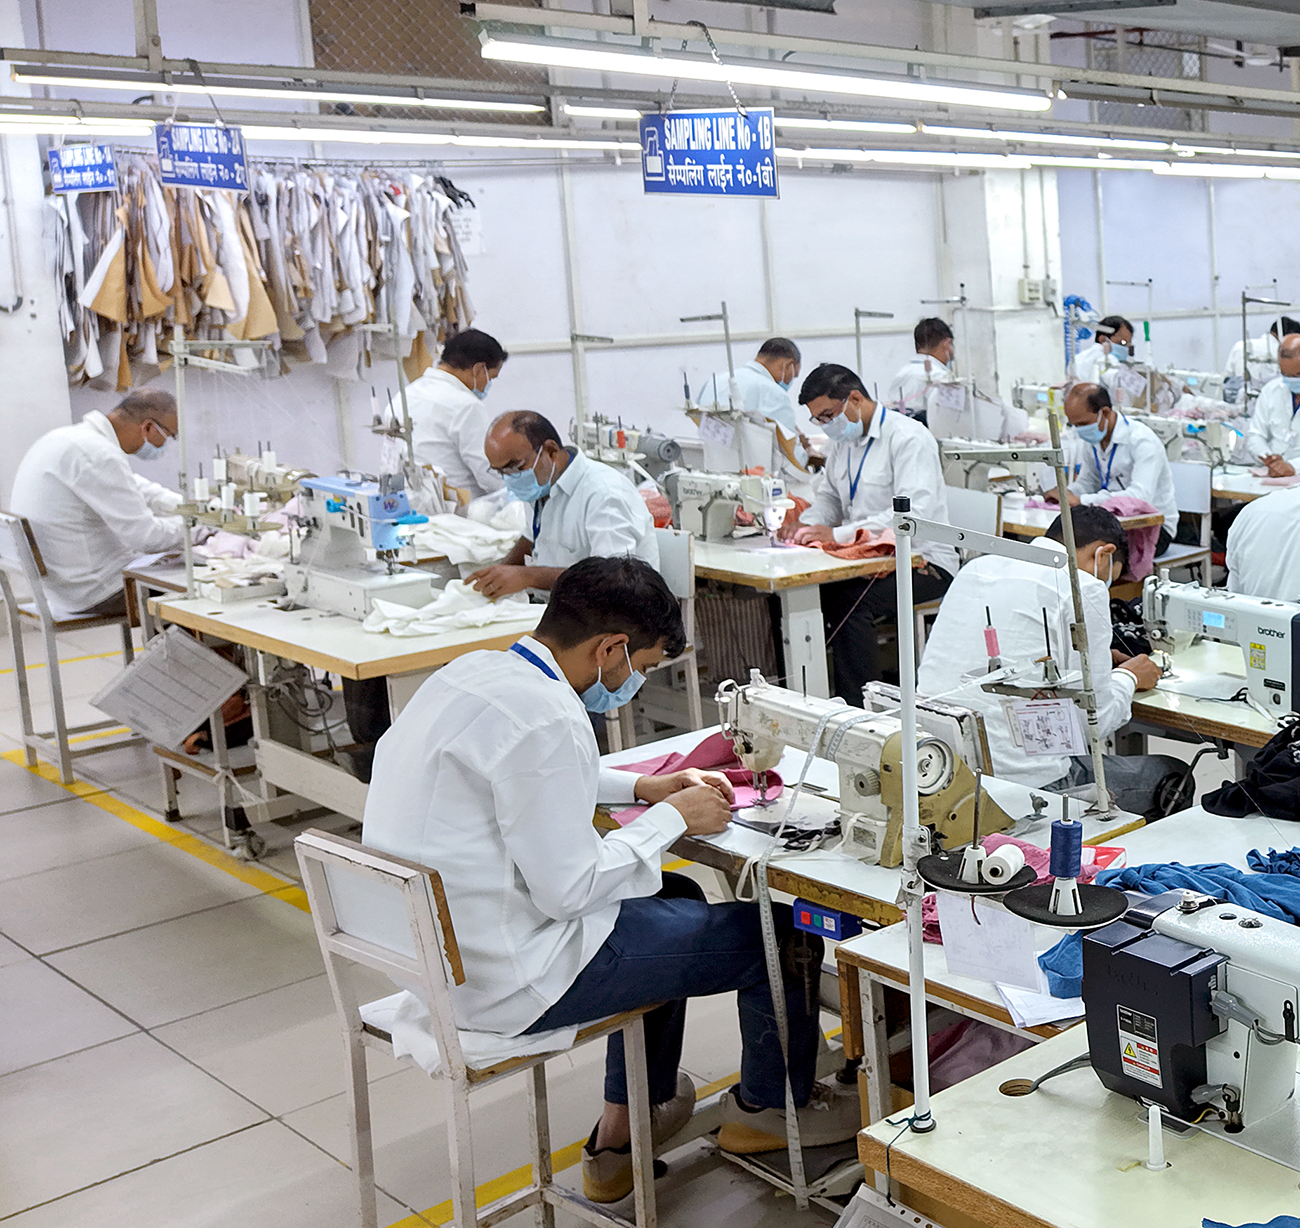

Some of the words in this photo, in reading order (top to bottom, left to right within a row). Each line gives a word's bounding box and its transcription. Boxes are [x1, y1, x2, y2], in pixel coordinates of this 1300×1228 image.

[664, 117, 712, 151] SAMPLING
[713, 117, 736, 150] LINE
[737, 116, 751, 150] No
[758, 116, 771, 150] 1B
[706, 153, 733, 193] लाईन
[1257, 625, 1285, 639] brother
